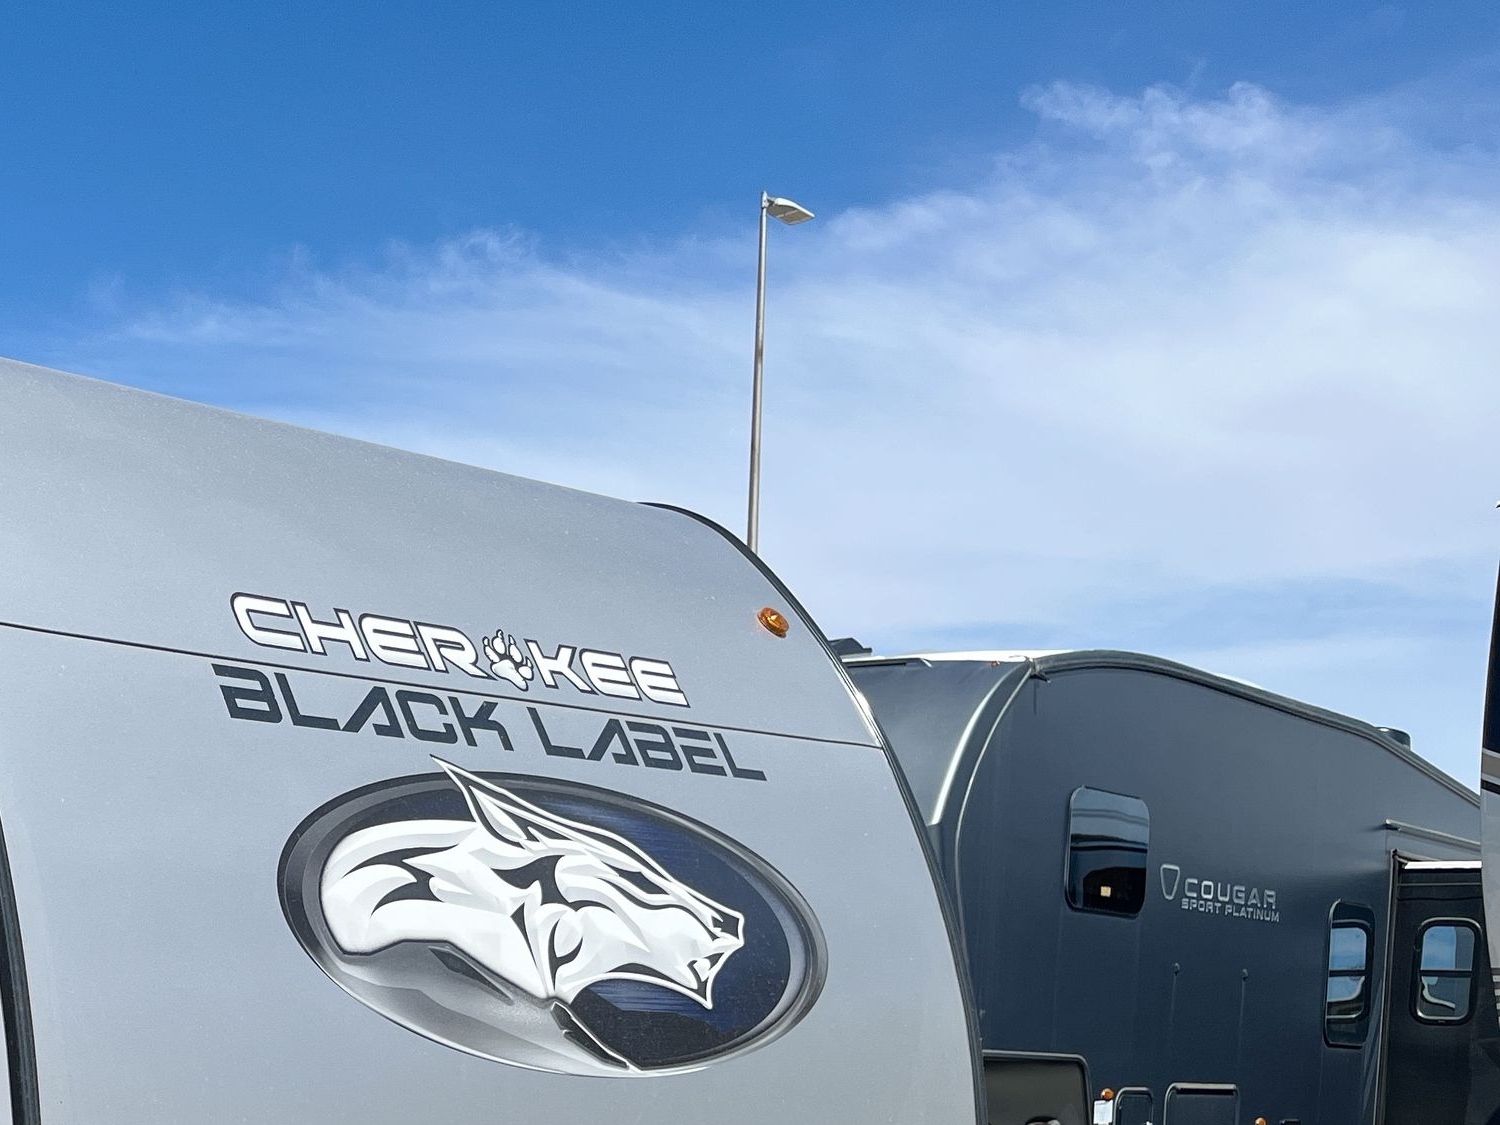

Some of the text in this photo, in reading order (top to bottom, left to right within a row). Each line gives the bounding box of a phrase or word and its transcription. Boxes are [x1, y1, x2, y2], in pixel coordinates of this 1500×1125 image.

[211, 662, 768, 782] BLACK LABEL
[1181, 898, 1280, 922] SPORT PLATINUM
[1184, 878, 1277, 910] COUGAR
